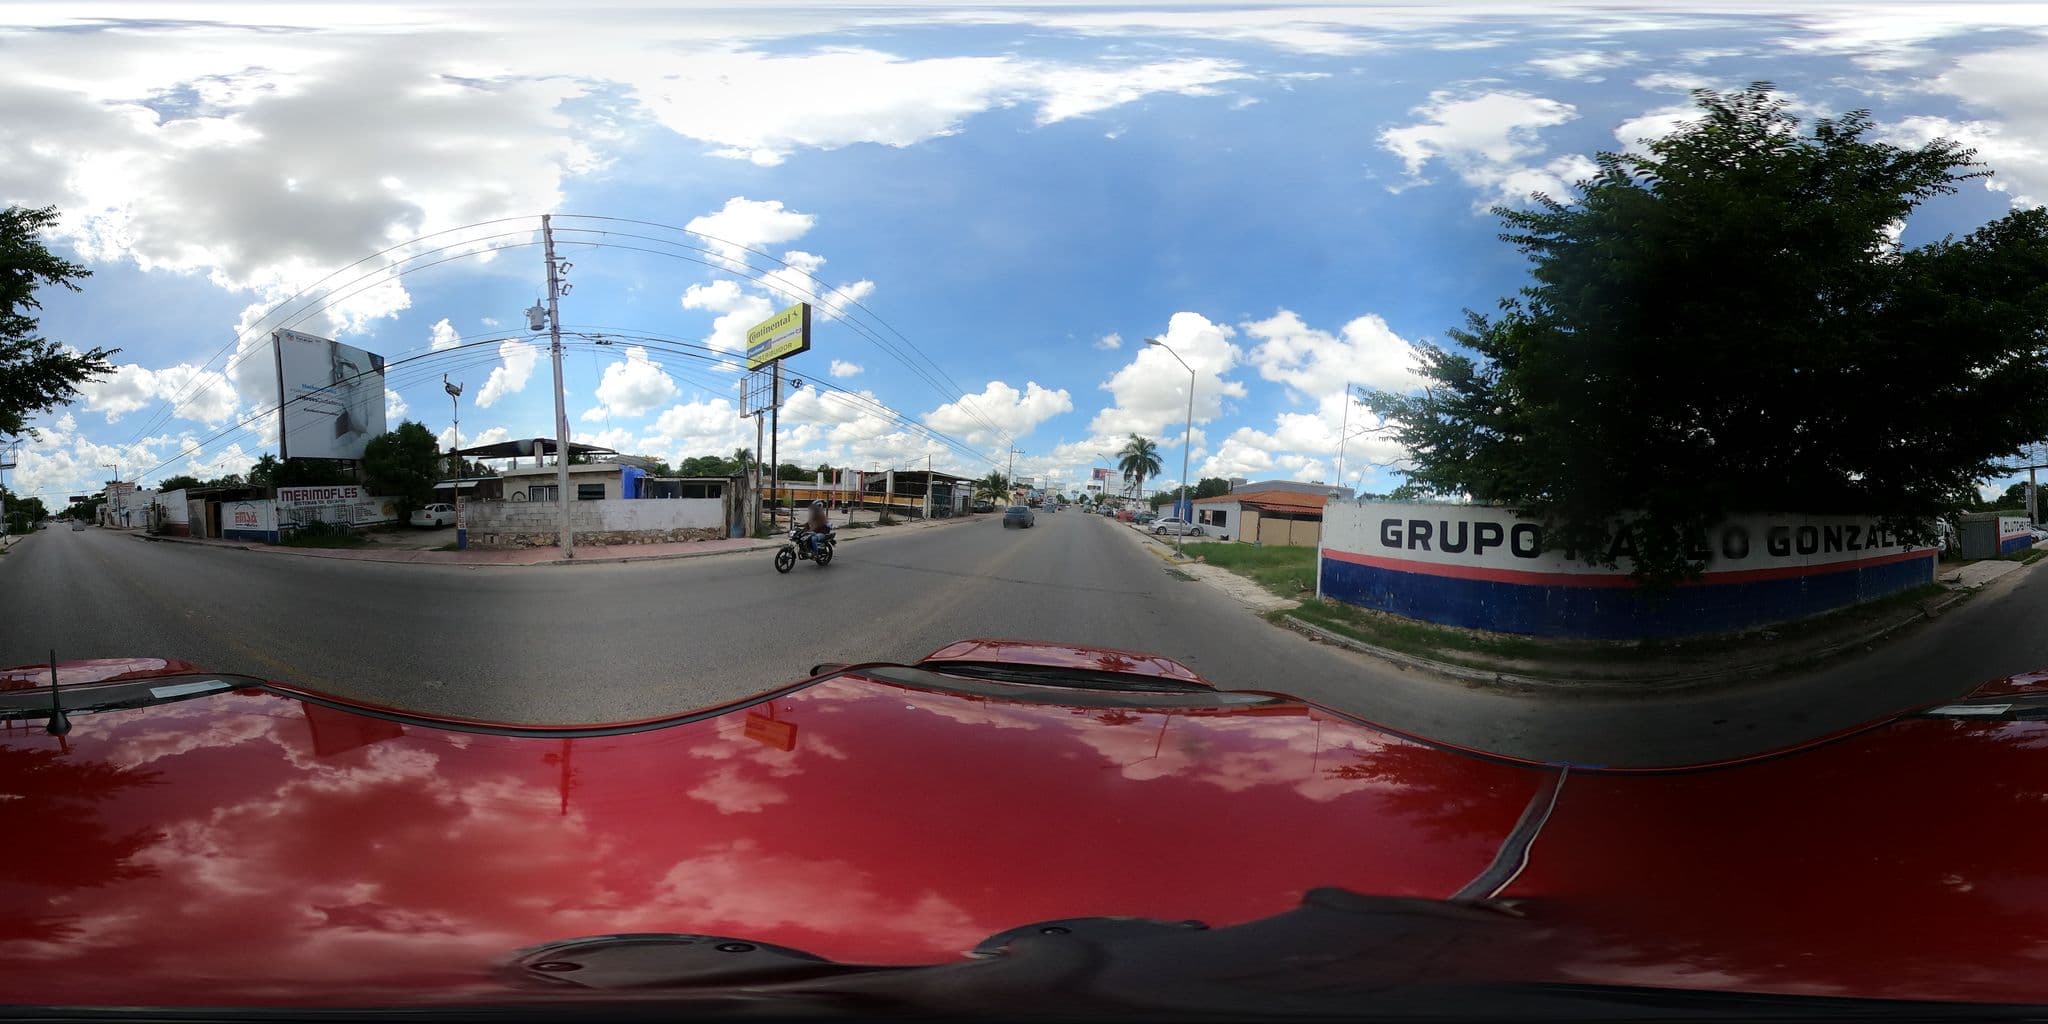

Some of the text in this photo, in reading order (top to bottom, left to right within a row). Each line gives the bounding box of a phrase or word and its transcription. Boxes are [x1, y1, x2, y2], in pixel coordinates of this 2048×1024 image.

[749, 313, 791, 343] Continental
[281, 487, 358, 502] MERIMOFLES
[1380, 518, 1543, 559] GRUPO
